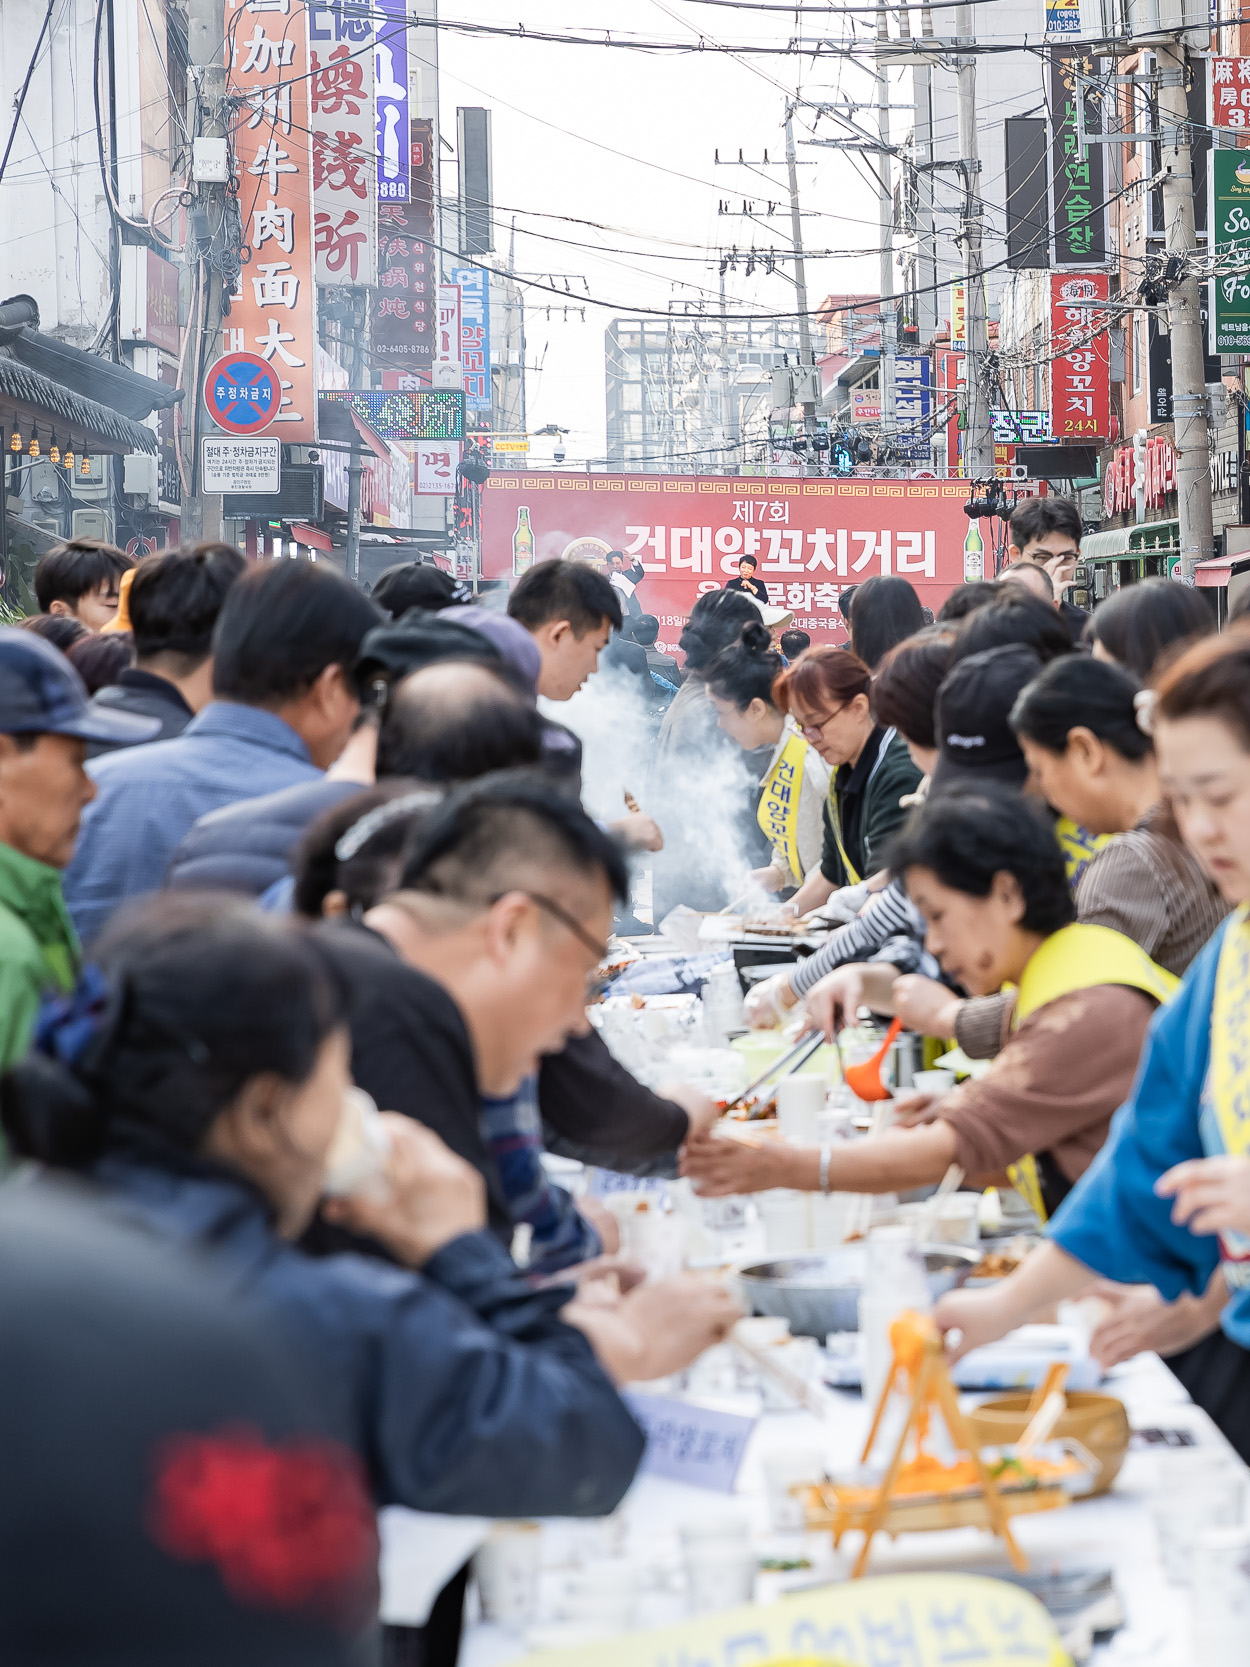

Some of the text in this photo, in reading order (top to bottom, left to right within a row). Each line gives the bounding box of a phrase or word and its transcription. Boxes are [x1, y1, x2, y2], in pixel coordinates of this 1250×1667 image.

[377, 344, 430, 354] 02-6405-8786
[216, 386, 272, 401] 주정차금지
[1064, 418, 1099, 433] 24시
[206, 446, 221, 458] 절대
[732, 500, 790, 525] 제7회
[622, 523, 937, 579] 건대양꼬치거리
